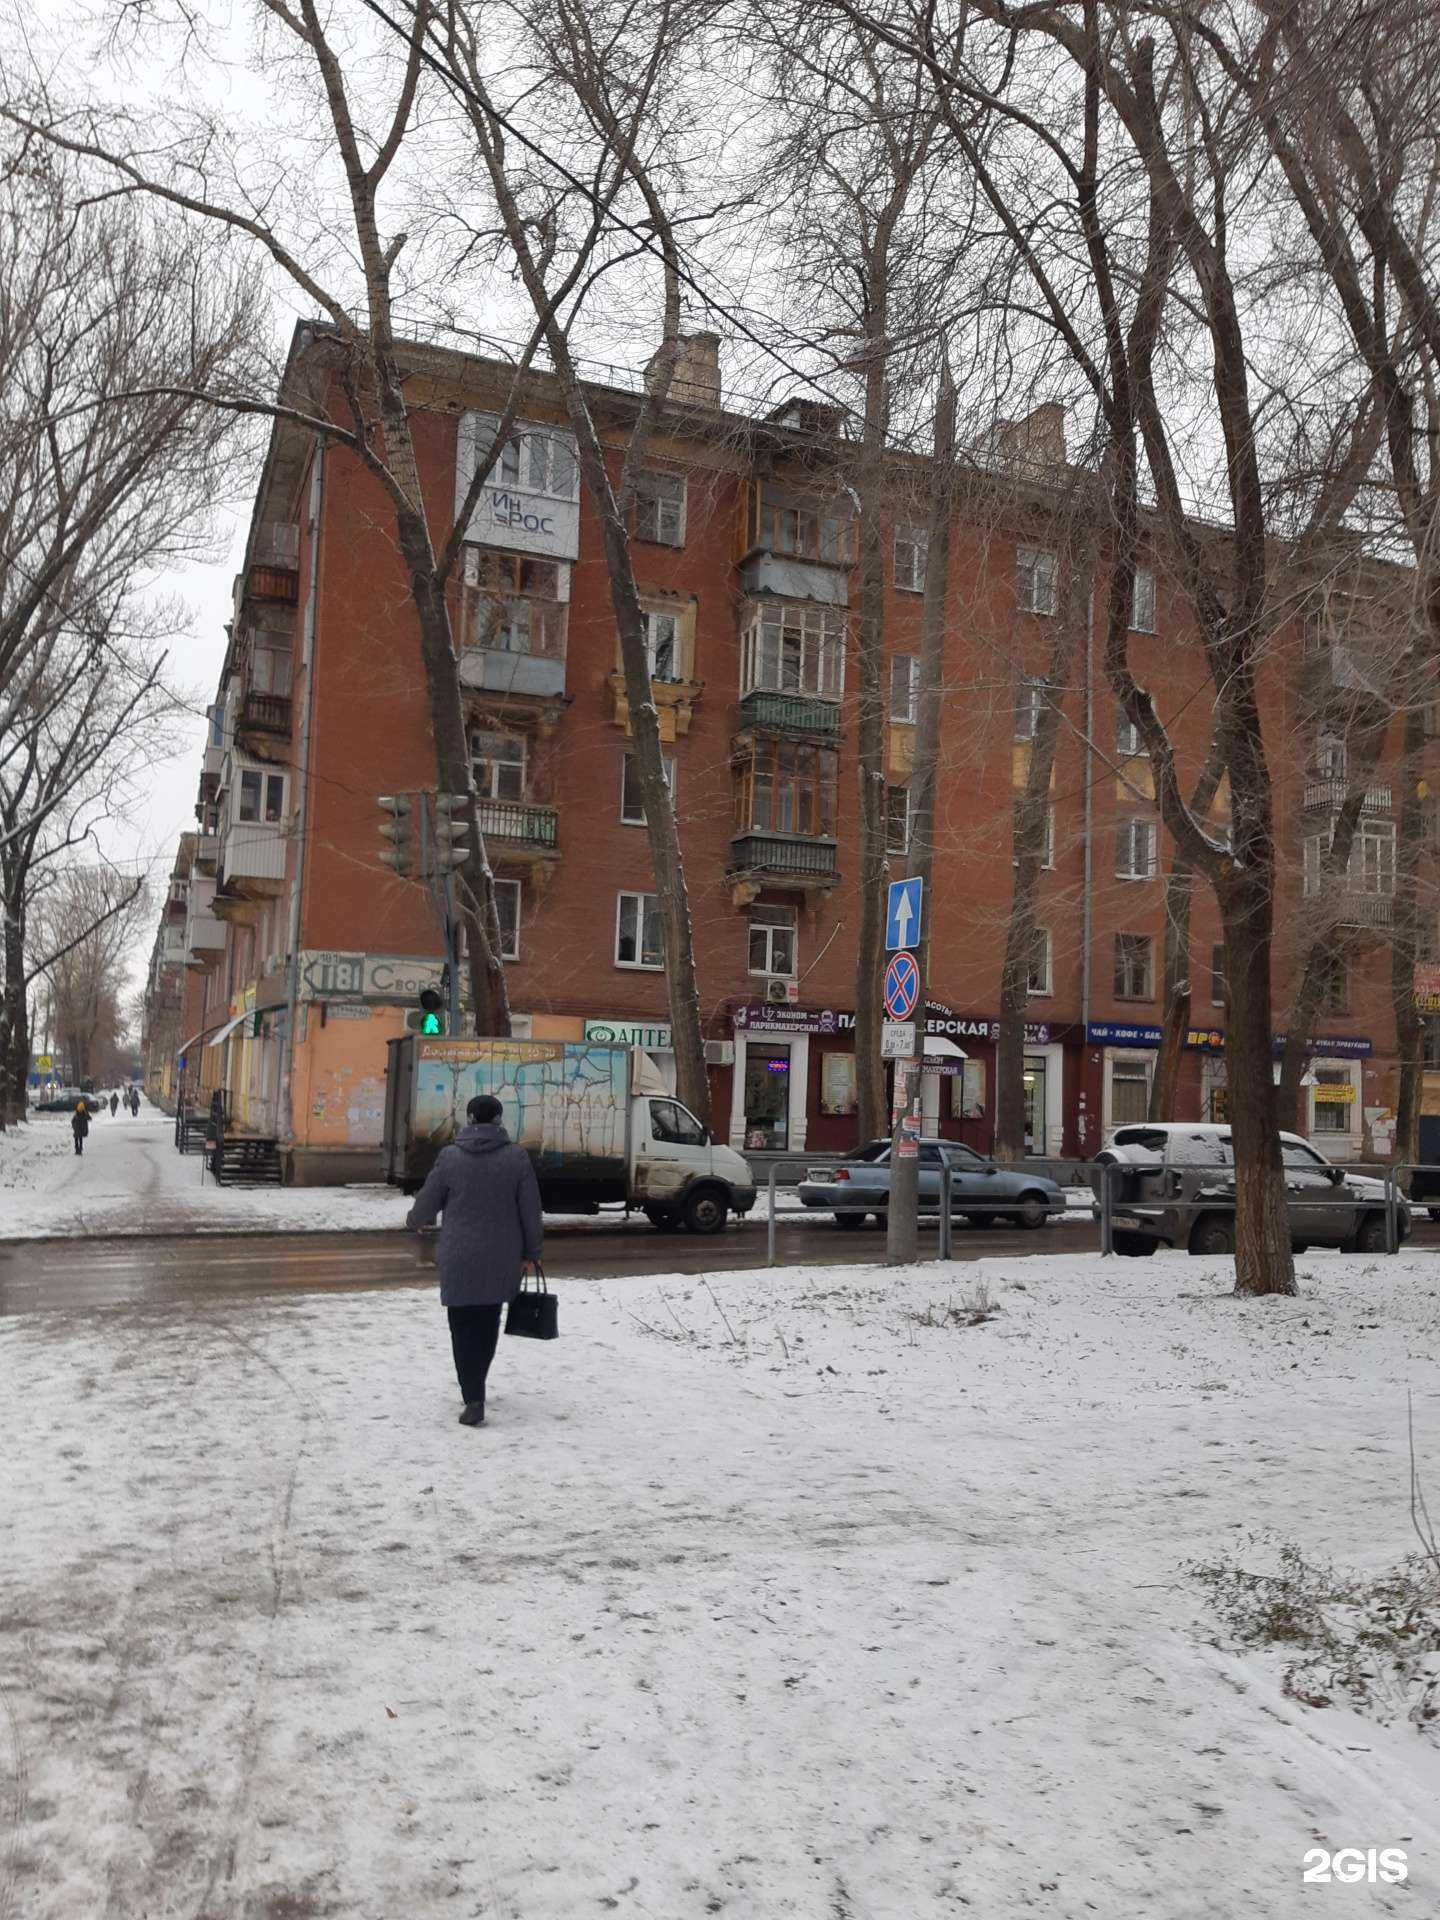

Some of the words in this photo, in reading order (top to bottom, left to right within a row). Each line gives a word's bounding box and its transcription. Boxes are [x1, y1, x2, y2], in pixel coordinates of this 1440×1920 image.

[325, 965, 361, 991] 181
[925, 1001, 953, 1016] АСОТЫ
[750, 1021, 819, 1033] ПАРИКМАХЕРСКАЯ
[1091, 1028, 1108, 1036] ЧАЙ
[1115, 1030, 1138, 1038] КОФЕ
